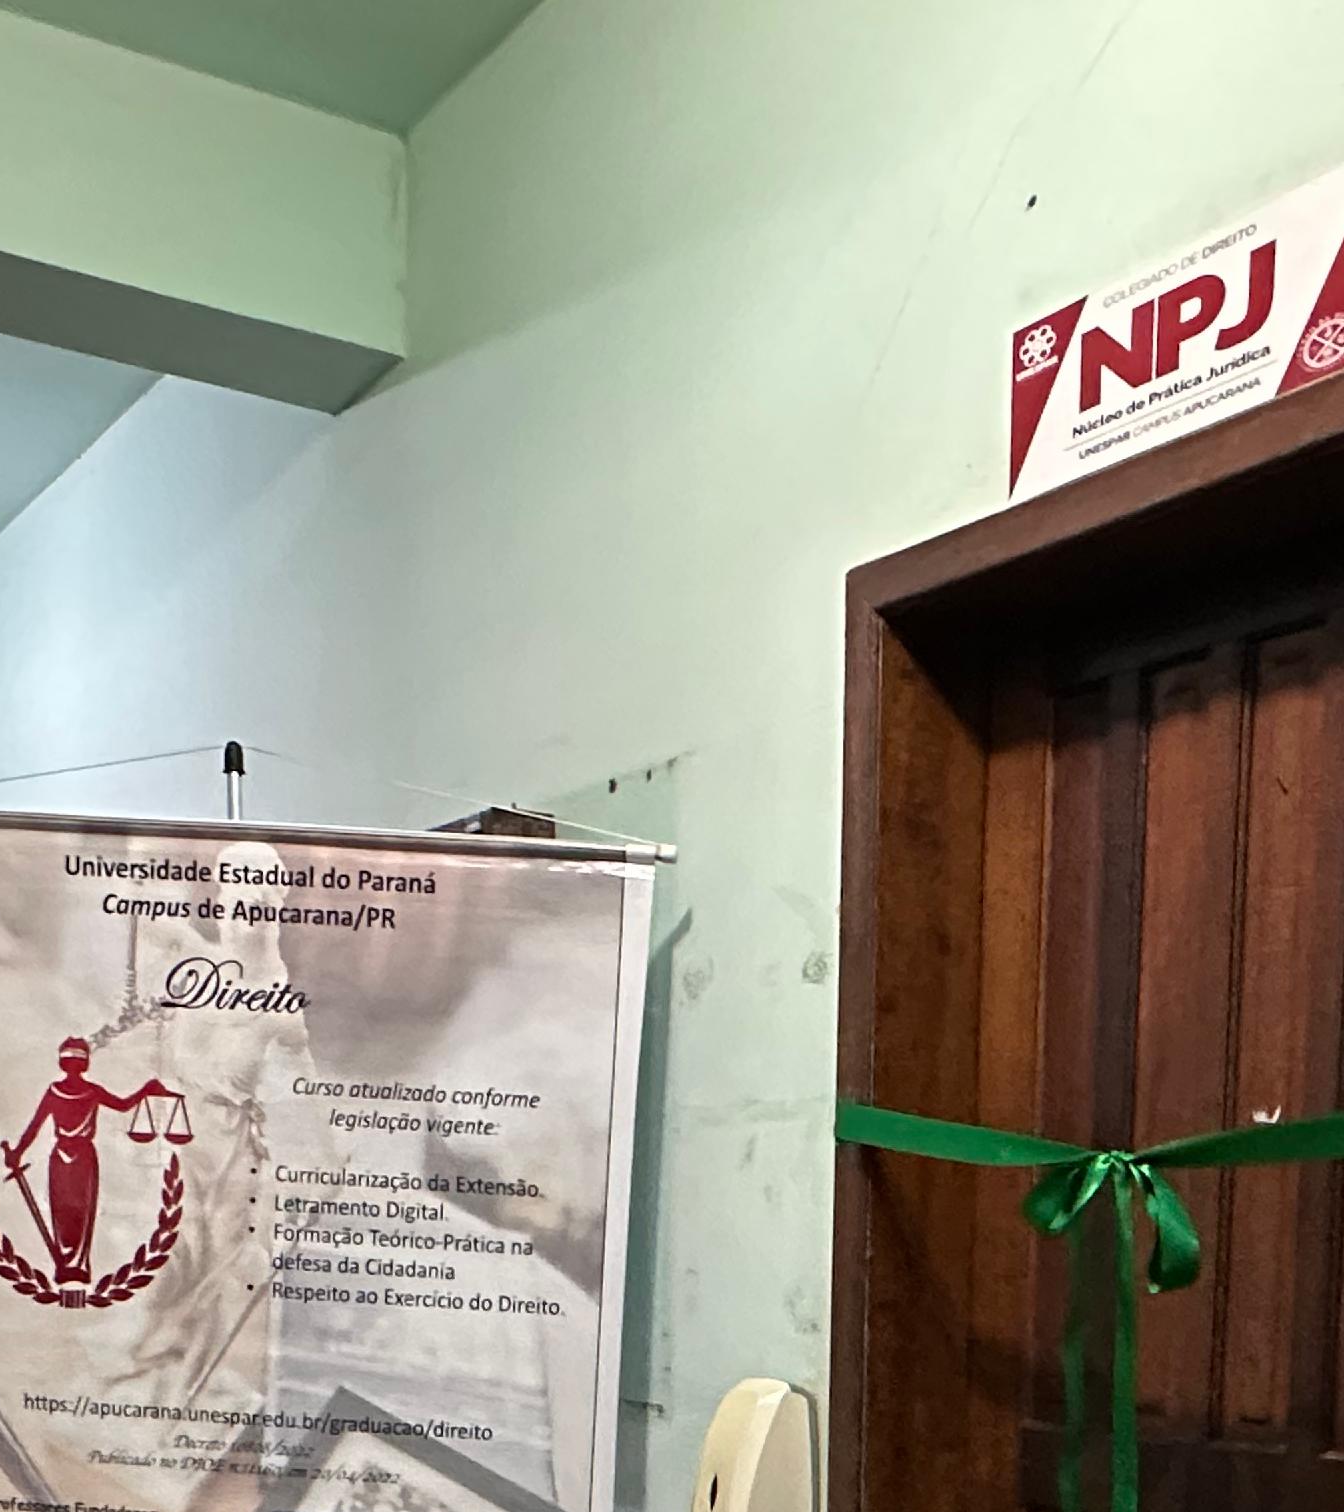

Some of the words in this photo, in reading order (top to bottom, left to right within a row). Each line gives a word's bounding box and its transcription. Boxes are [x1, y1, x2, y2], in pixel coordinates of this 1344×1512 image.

[1102, 263, 1179, 308] COLEGIADO
[1180, 251, 1200, 270] DE
[1202, 223, 1258, 259] DIREITO
[1079, 239, 1277, 414] NPJ
[1072, 409, 1123, 439] Núcleo
[1126, 399, 1146, 416] de
[1149, 374, 1203, 406] Prática
[1206, 345, 1271, 382] Jurídica
[1078, 431, 1131, 459] UNESPAR
[1183, 377, 1262, 416] APUCARANA
[64, 855, 212, 883] Universidade
[219, 863, 315, 888] Estadual
[322, 867, 351, 890] do
[358, 870, 436, 894] Paraná
[102, 894, 191, 920] Campus
[198, 898, 226, 920] de
[232, 900, 396, 931] Apucarana/PR
[160, 957, 311, 1014] Direito
[292, 1077, 344, 1097] Curso
[348, 1082, 447, 1103] atualizado
[452, 1086, 541, 1110] conforme
[329, 1109, 421, 1134] legislação
[275, 1165, 422, 1193] Curricularização
[427, 1172, 450, 1191] da
[456, 1176, 545, 1198] Extensão.
[275, 1195, 380, 1218] Letramento
[387, 1201, 449, 1224] Digital.
[273, 1224, 364, 1248] Formação
[370, 1229, 505, 1254] Teórico-Prática
[511, 1239, 534, 1255] na
[272, 1253, 331, 1273] defesa
[338, 1256, 360, 1274] da
[366, 1258, 456, 1280] Cidadania
[272, 1282, 350, 1304] Respeito
[356, 1288, 378, 1304] ao
[384, 1287, 464, 1309] Exercício
[469, 1291, 492, 1310] do
[499, 1295, 566, 1316] Direito.
[23, 1392, 493, 1440] https://apucarana.unespar.edu.br/graduacao/direito
